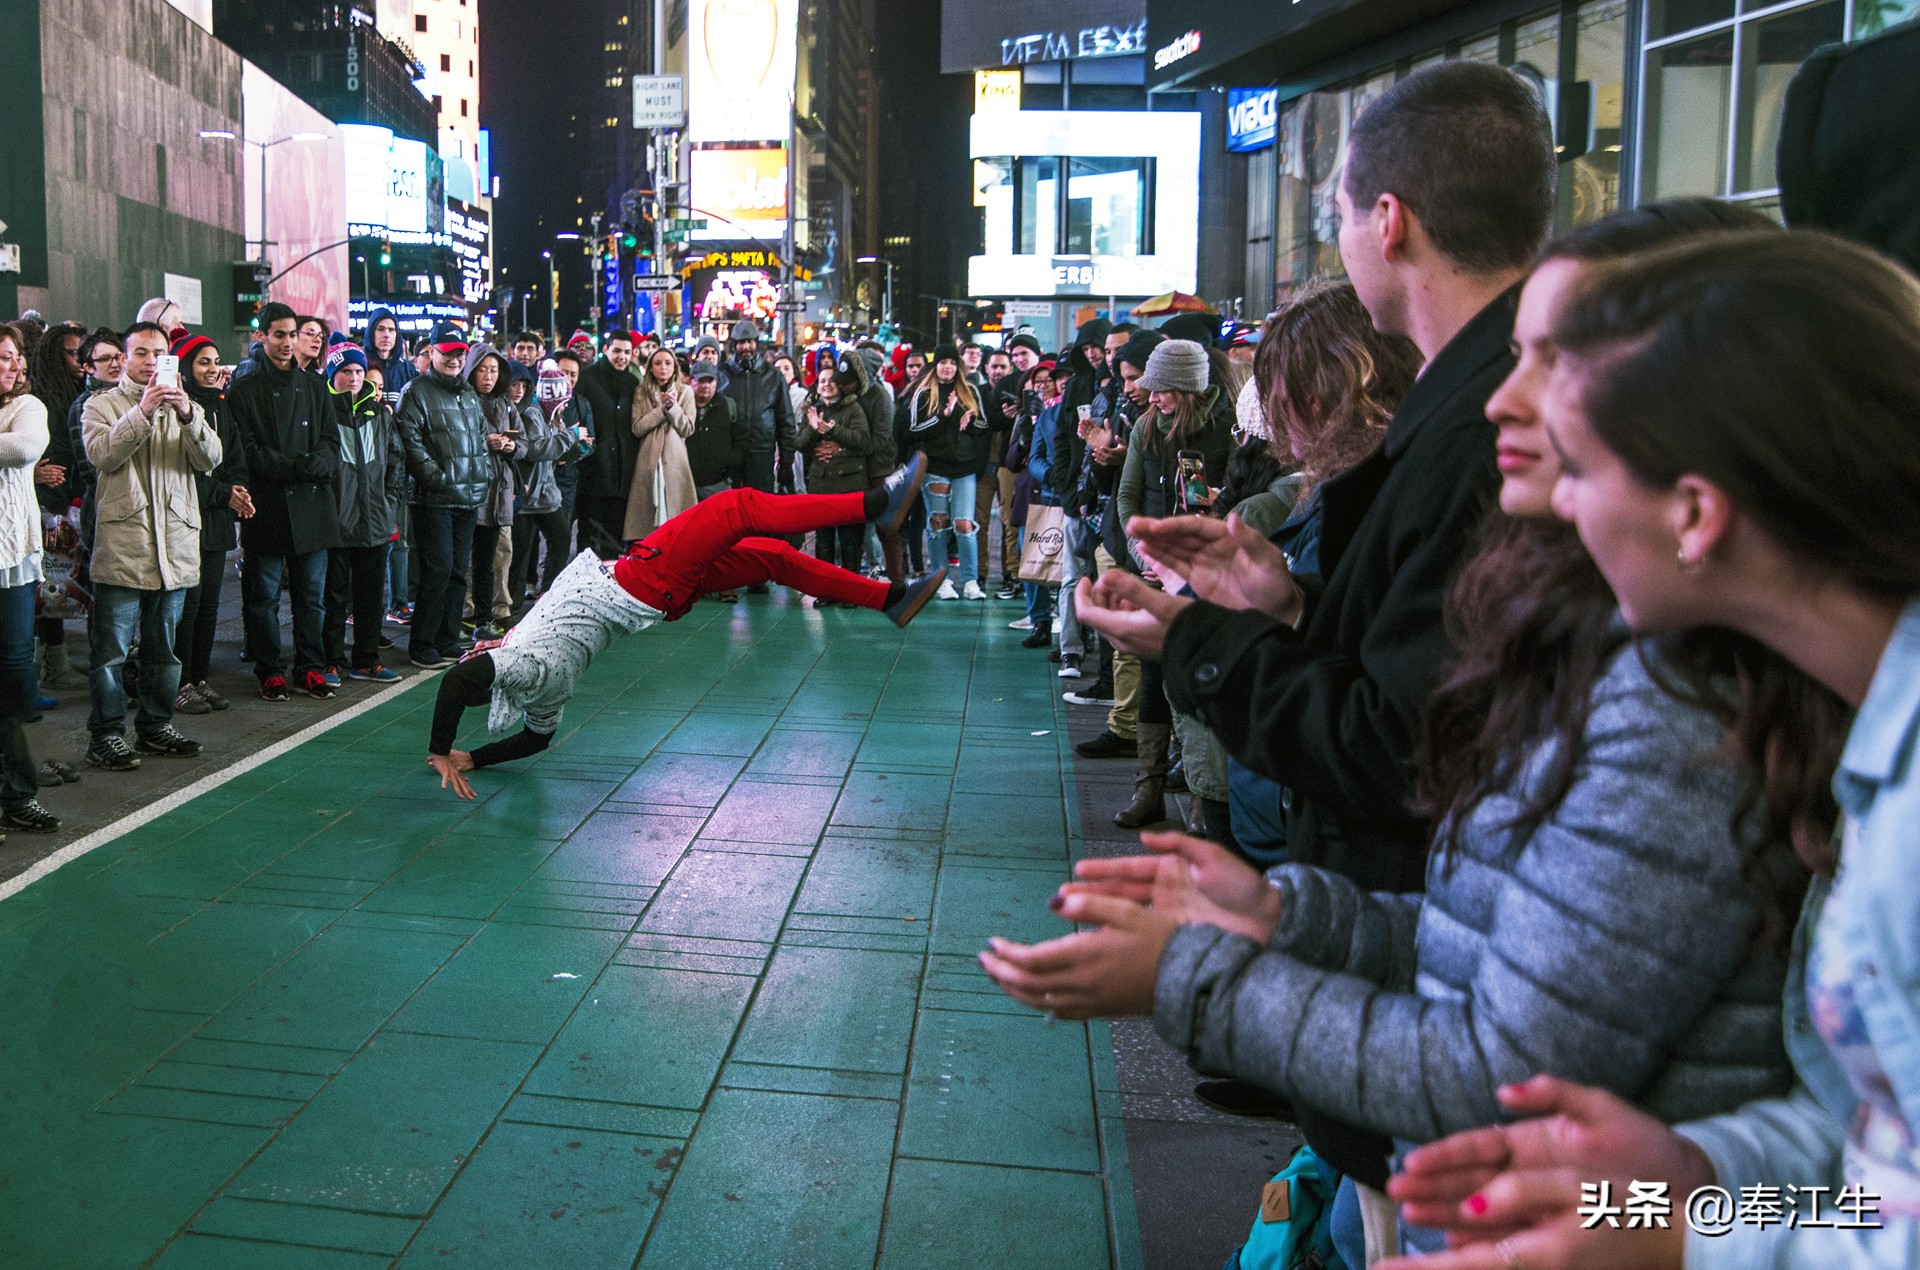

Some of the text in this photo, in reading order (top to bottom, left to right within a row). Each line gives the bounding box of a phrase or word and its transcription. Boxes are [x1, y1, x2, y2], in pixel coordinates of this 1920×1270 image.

[1154, 29, 1194, 70] swatch
[347, 33, 359, 91] 1500
[636, 81, 681, 91] RIGHT LANE
[645, 96, 671, 106] MUST
[636, 111, 682, 120] TURN RIGHT
[1029, 532, 1064, 546] Hard Ro
